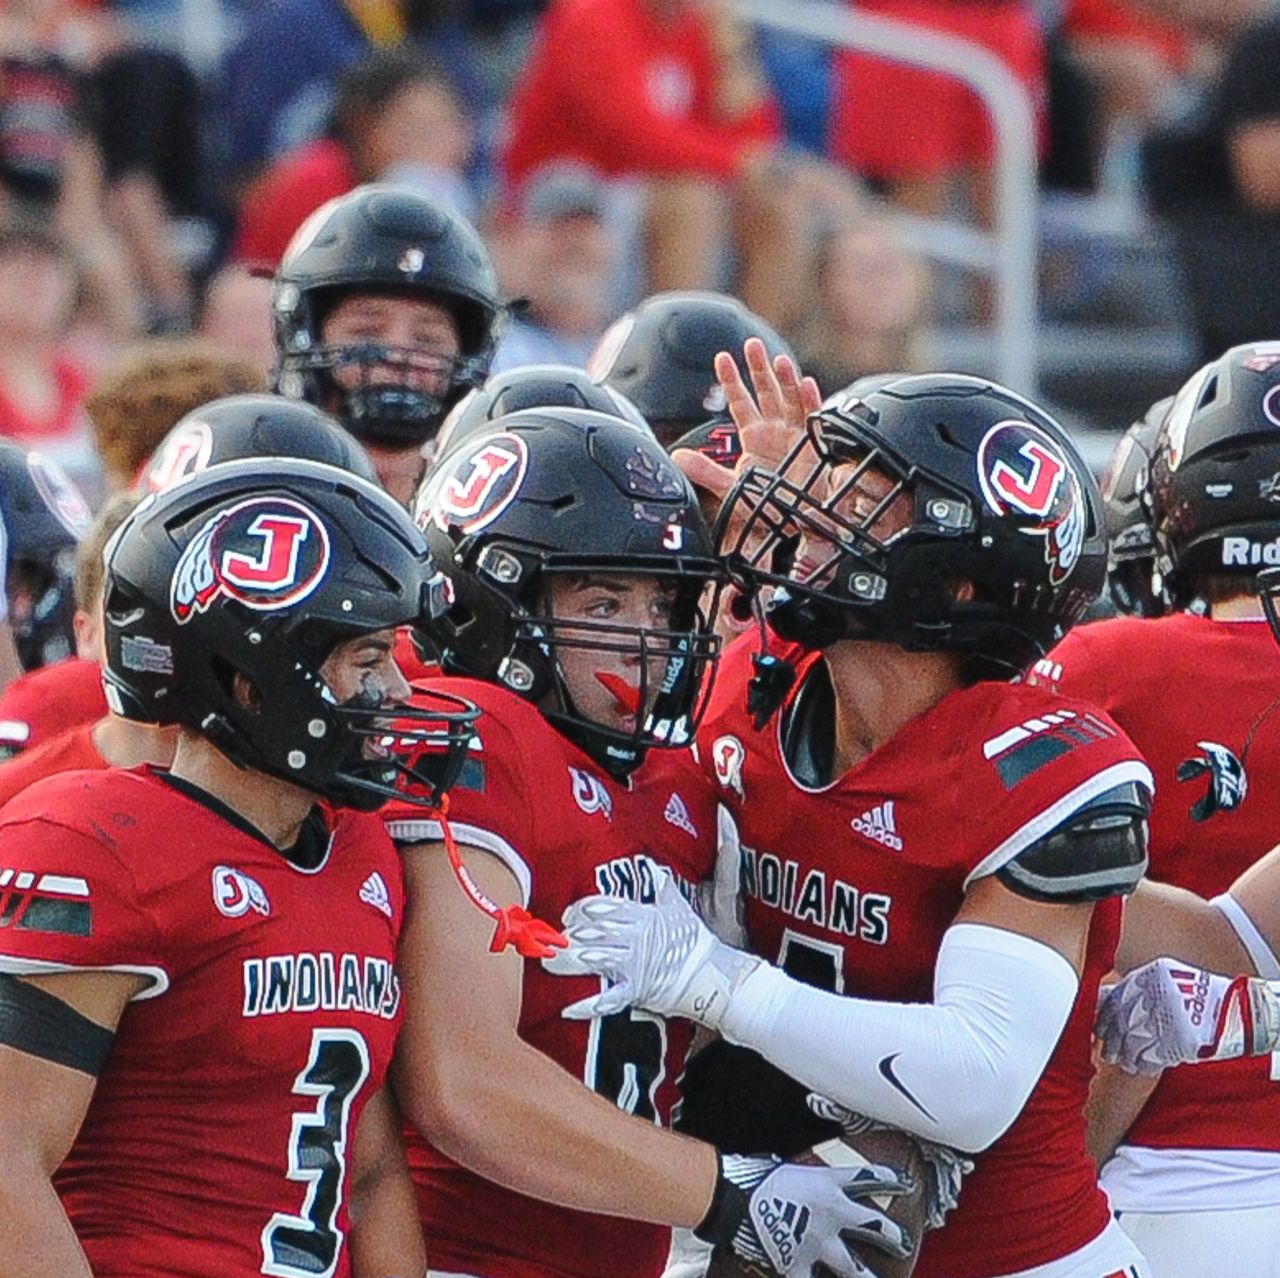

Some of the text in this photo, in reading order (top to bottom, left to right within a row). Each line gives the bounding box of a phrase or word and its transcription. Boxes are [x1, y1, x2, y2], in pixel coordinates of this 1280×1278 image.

[445, 446, 517, 515] J
[991, 444, 1065, 517] J
[221, 512, 312, 592] J
[851, 818, 903, 851] adidas
[243, 953, 401, 1020] INDIANS
[758, 1199, 794, 1267] adidas
